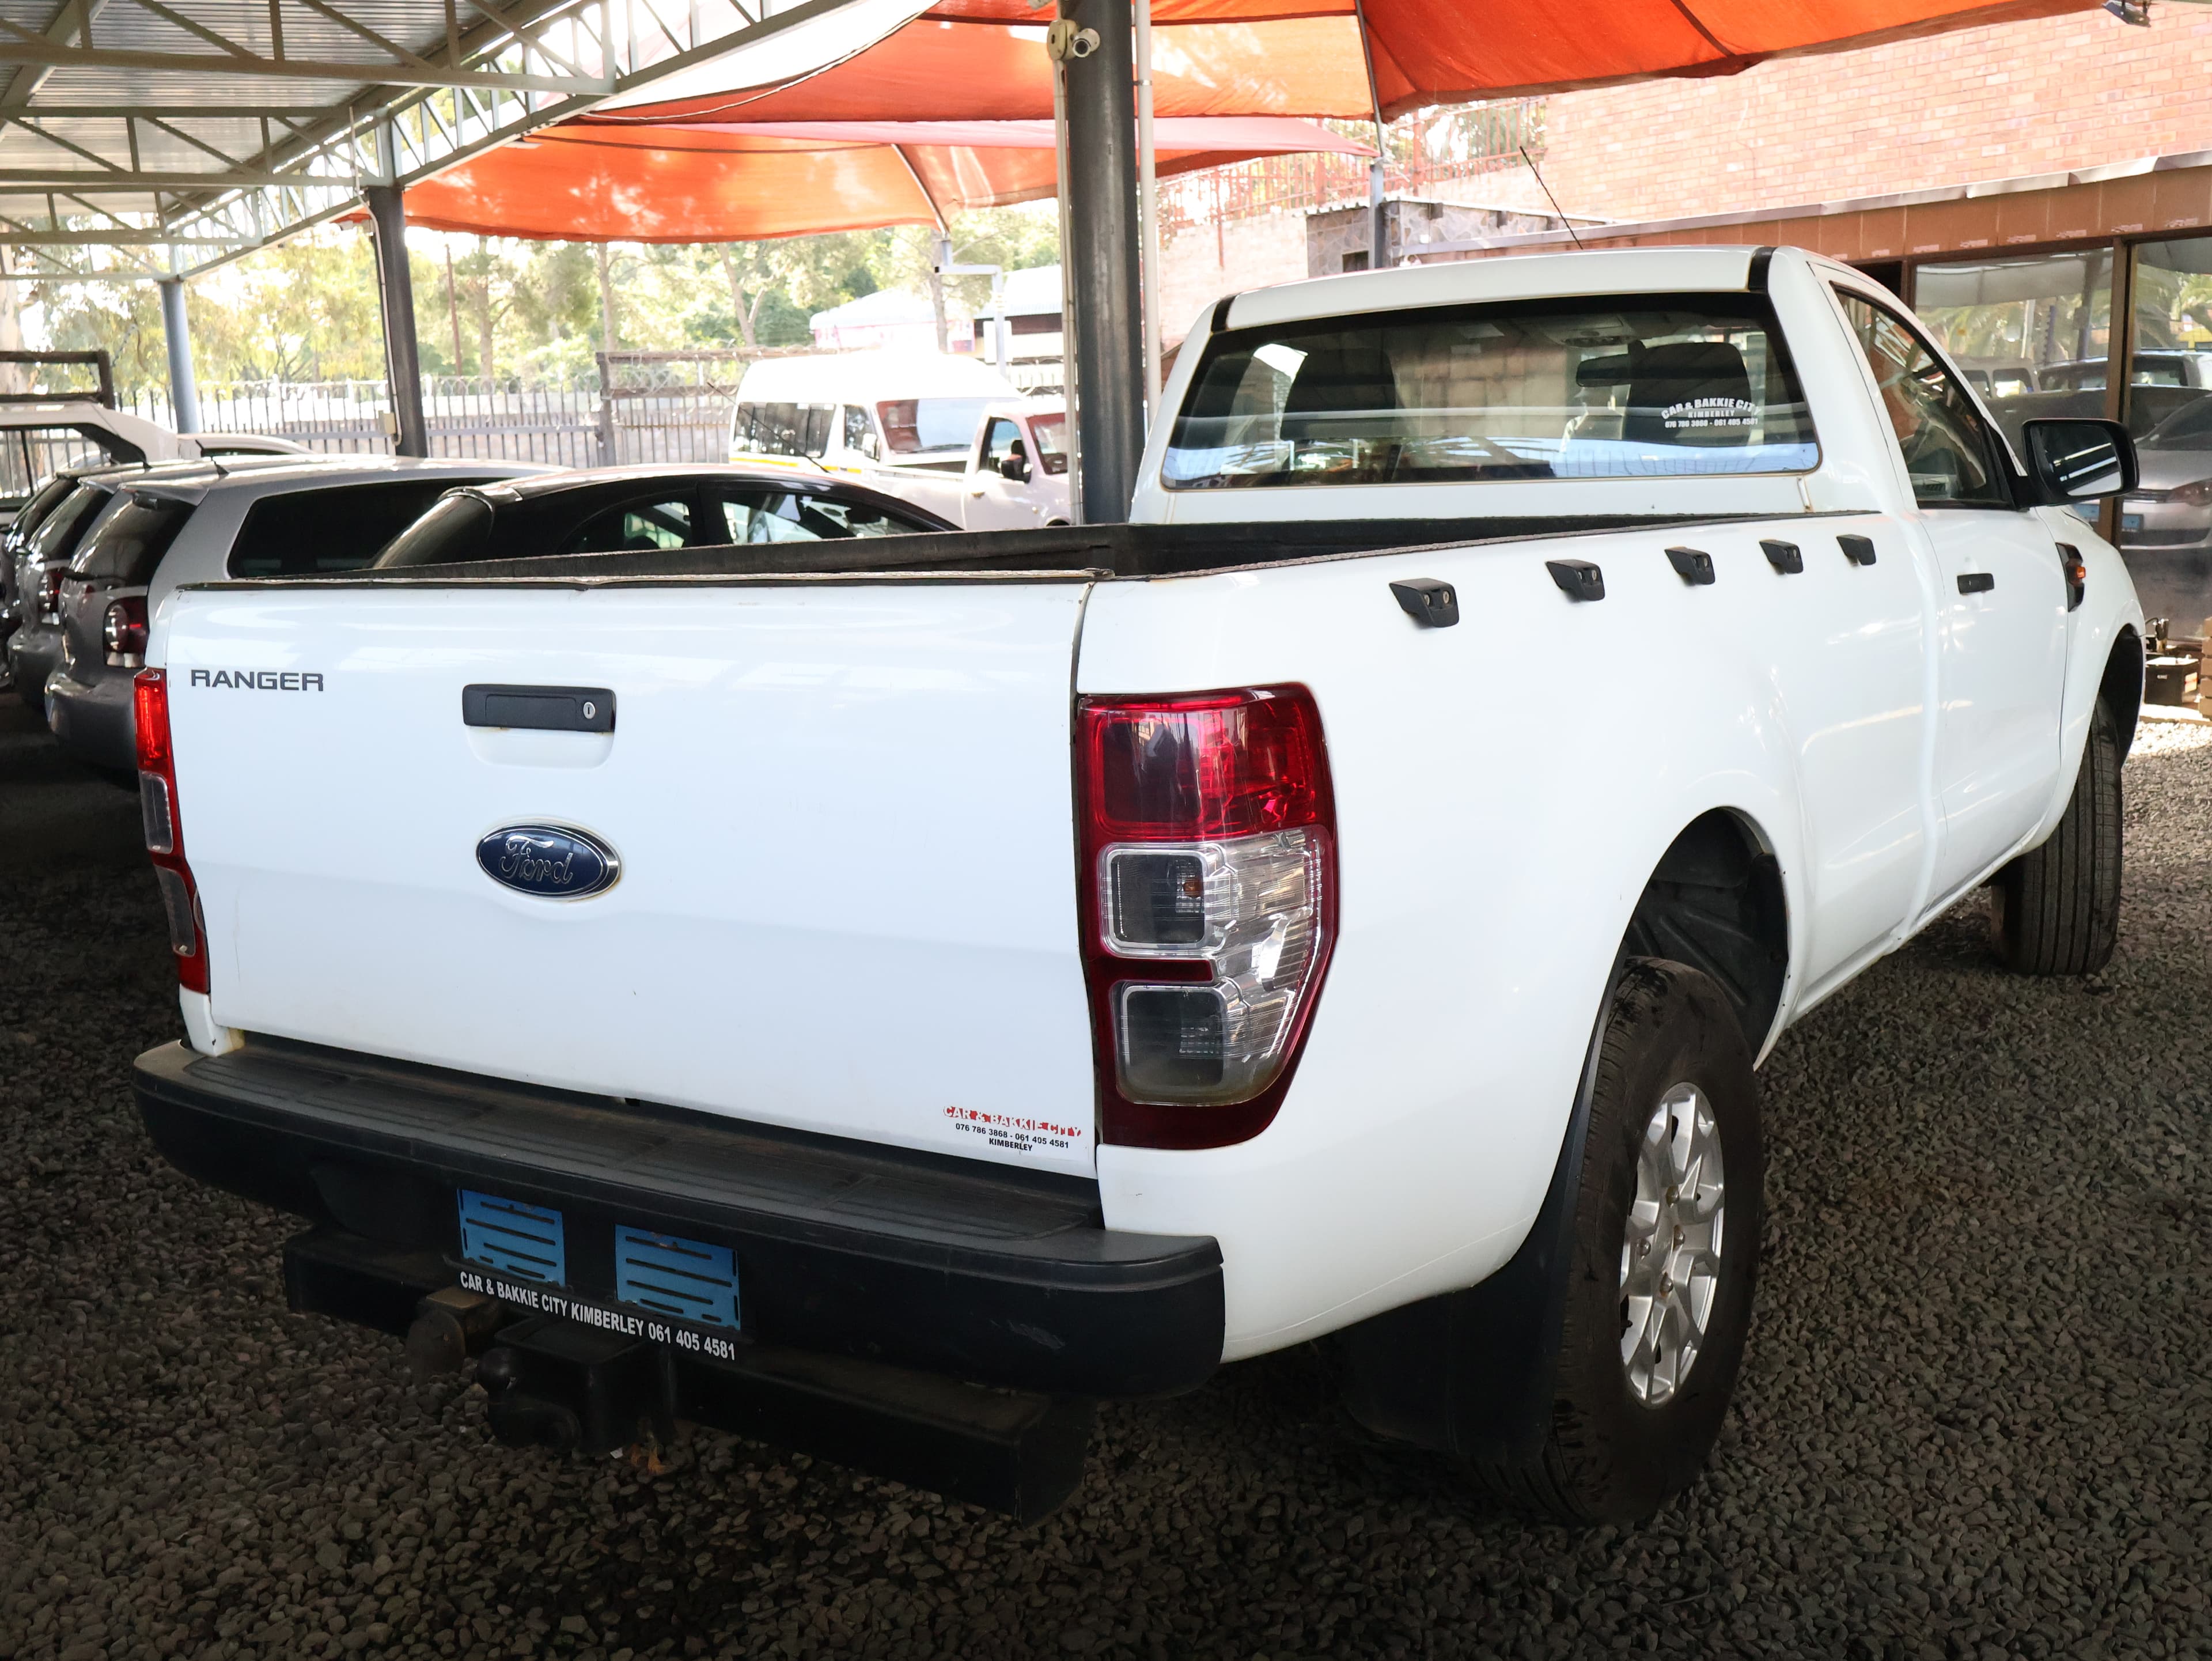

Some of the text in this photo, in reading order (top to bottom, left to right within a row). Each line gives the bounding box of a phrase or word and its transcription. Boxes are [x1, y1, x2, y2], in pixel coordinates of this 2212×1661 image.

[1661, 398, 1762, 419] CAR & BAKKIE CITY
[191, 669, 324, 691] RANGER
[499, 835, 574, 885] Ford
[943, 1105, 972, 1120] CAR
[955, 1123, 970, 1132] 076
[972, 1125, 987, 1134] 786
[988, 1129, 1007, 1138] 3868
[1015, 1133, 1029, 1142] 061
[1032, 1136, 1047, 1145] 405
[1049, 1138, 1069, 1148] 4581
[988, 1137, 1033, 1151] KIMBERLEY
[460, 1270, 736, 1361] CAR & BAKKIE CITY KIMBERLEY 061 405 4581
